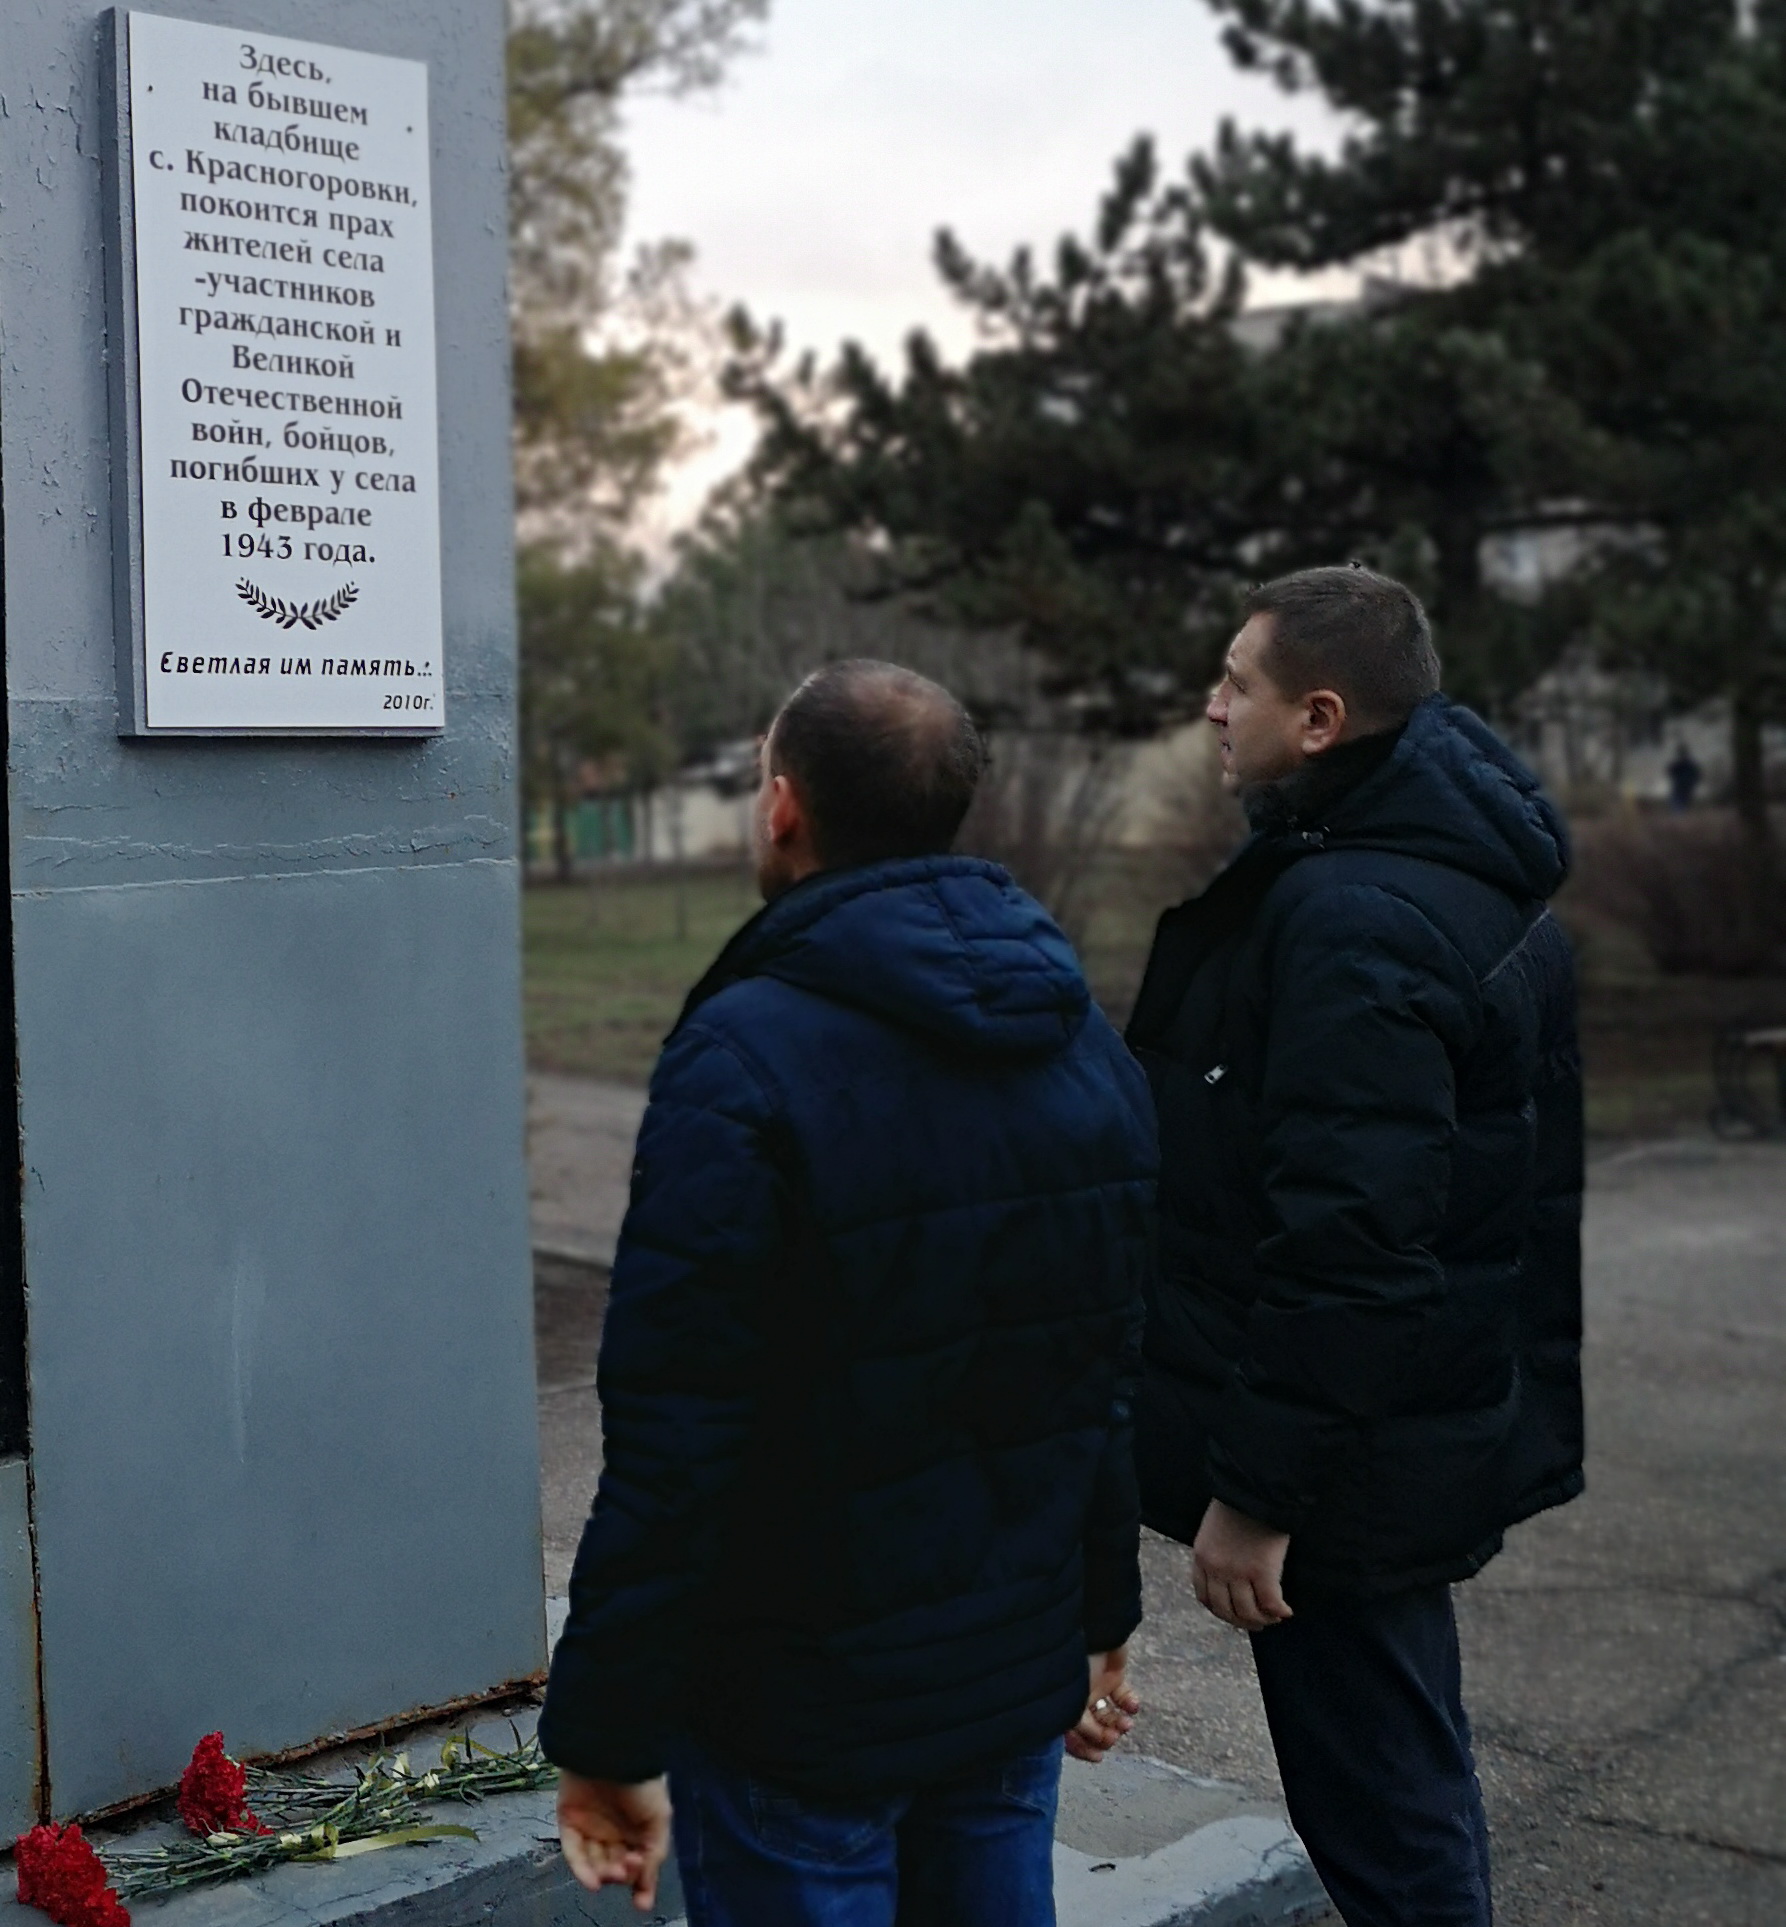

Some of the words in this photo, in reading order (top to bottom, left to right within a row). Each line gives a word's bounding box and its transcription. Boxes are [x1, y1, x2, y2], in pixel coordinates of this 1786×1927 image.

[202, 82, 237, 105] на
[248, 81, 368, 126] бывшем
[213, 121, 360, 164] кладбище
[149, 150, 174, 171] с.
[186, 149, 418, 208] Красногоровки,
[180, 192, 318, 229] покоится
[329, 212, 395, 241] прах
[183, 231, 313, 264] жителей
[323, 248, 385, 273] села
[195, 271, 376, 308] -участников
[179, 307, 376, 346] гражданской
[386, 328, 402, 348] и
[232, 344, 355, 380] Великой
[181, 378, 403, 421] Отечественной
[192, 419, 272, 450] войн,
[283, 420, 395, 458] бойцов,
[170, 455, 321, 488] погибших
[330, 469, 346, 496] у
[355, 471, 417, 493] села
[220, 500, 238, 520] в
[248, 496, 373, 532] феврале
[222, 533, 294, 560] 1943
[303, 542, 376, 567] года.
[280, 657, 313, 676] им
